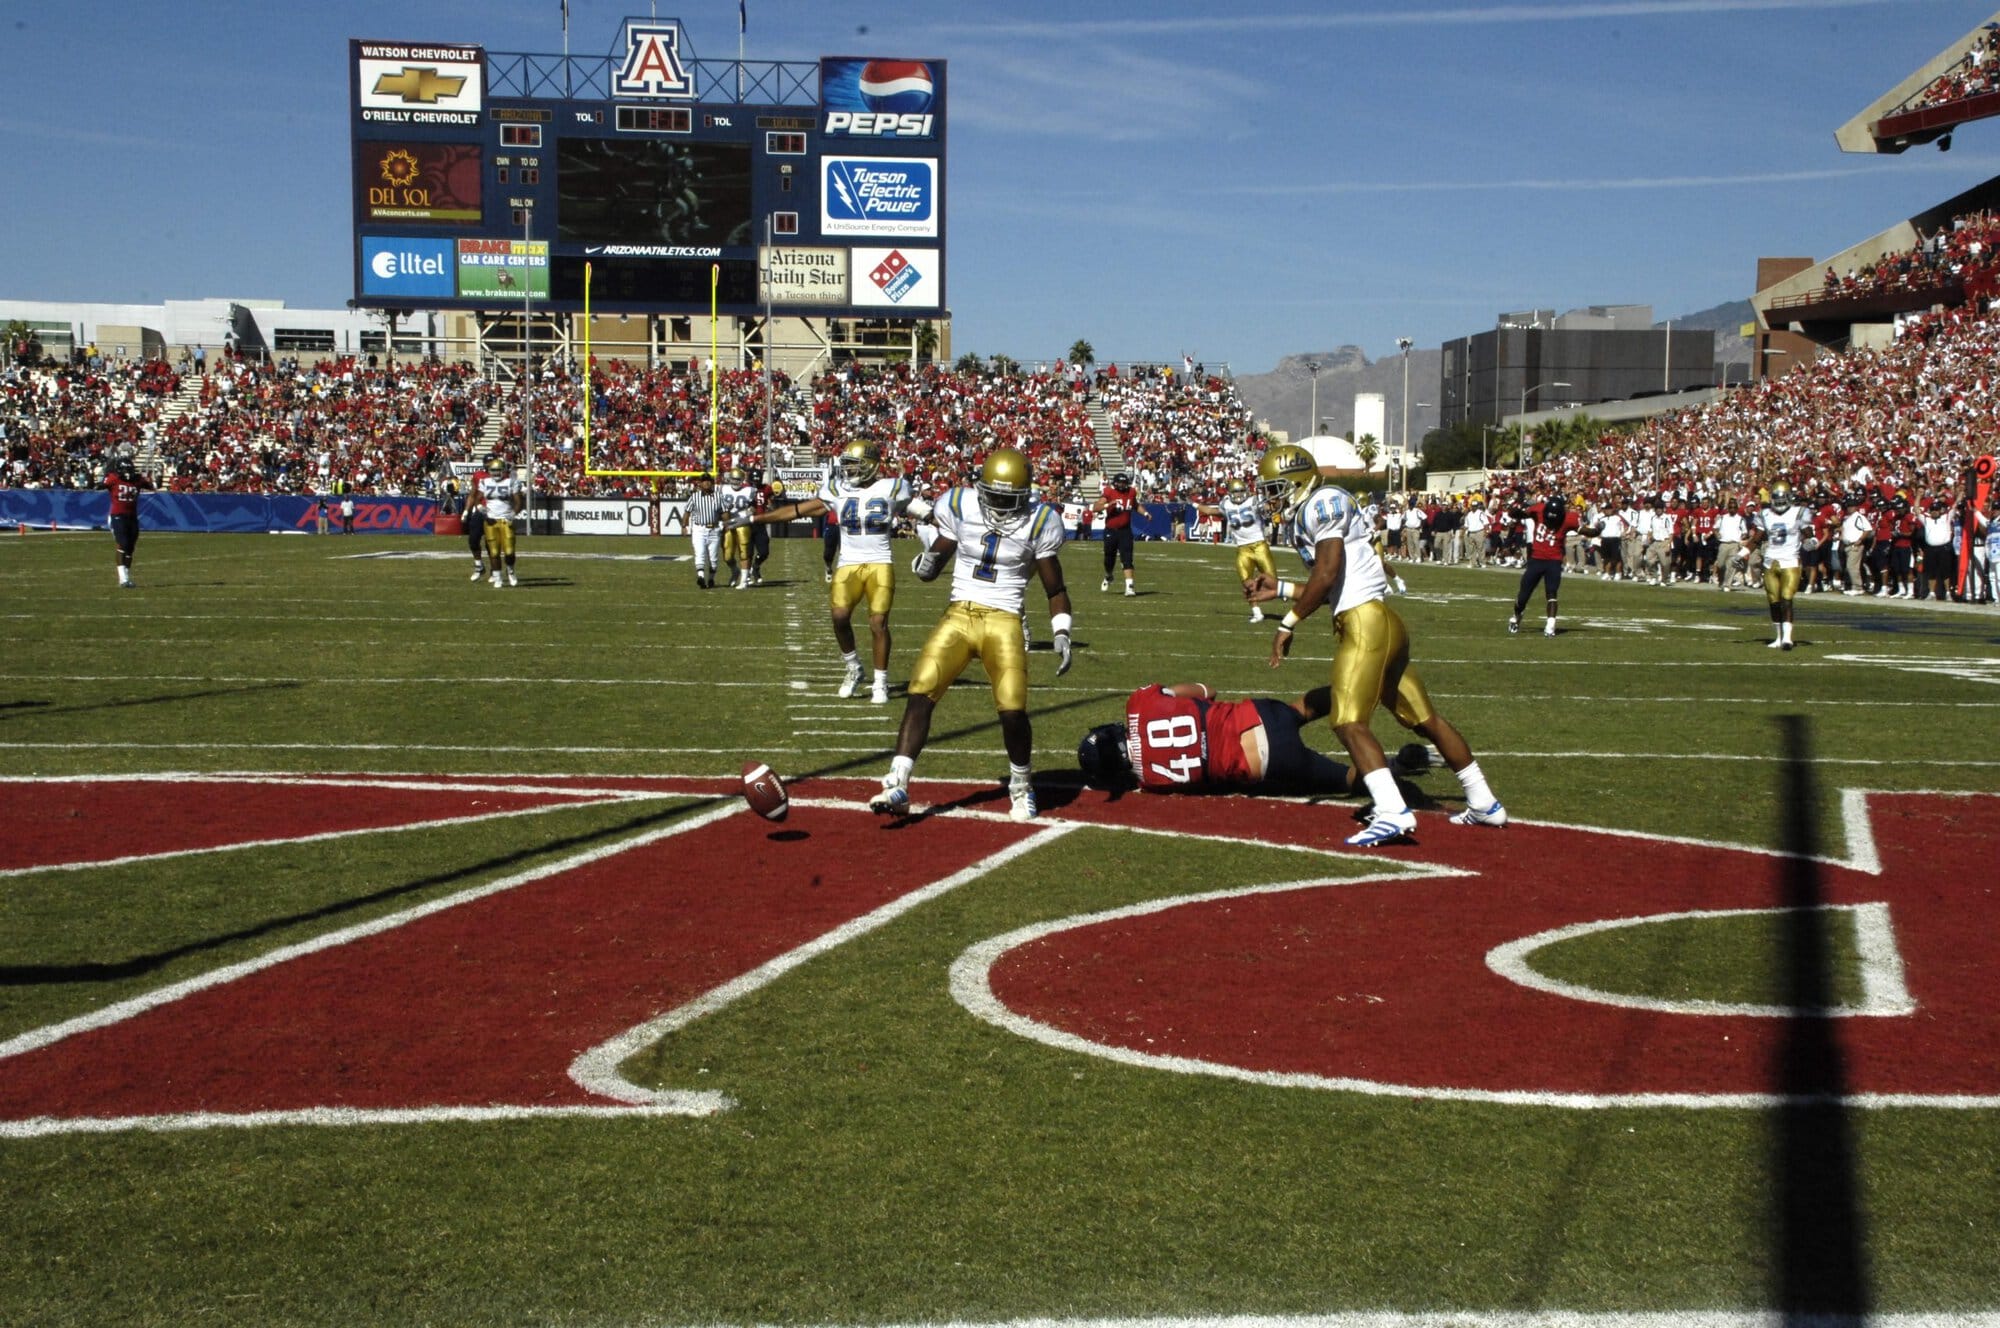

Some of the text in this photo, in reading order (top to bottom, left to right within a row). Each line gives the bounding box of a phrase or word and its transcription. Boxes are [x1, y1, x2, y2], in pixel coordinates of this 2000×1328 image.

[362, 46, 476, 60] WATSON CHEVROLET
[362, 110, 478, 124] O'RIELLY CHEVROLET
[576, 112, 594, 122] TOL
[713, 117, 732, 126] TOL
[825, 112, 933, 136] PEPSI
[853, 168, 907, 184] Tucson
[370, 187, 431, 207] DEL SOL
[858, 182, 921, 199] Electric
[864, 197, 921, 213] Power
[872, 224, 896, 232] Energy
[897, 224, 931, 232] Company
[603, 245, 721, 257] ARIZONAATHLETICS.COM
[770, 249, 835, 266] Arizona
[372, 252, 445, 278] alltel
[461, 255, 479, 265] CAR
[482, 255, 505, 265] CARE
[760, 268, 845, 288] Daily Star
[786, 290, 816, 299] Tucson
[819, 291, 843, 302] thing
[296, 502, 439, 528] ARZONA
[565, 510, 623, 521] MUSCLE MILK
[840, 496, 889, 536] 42
[1314, 495, 1344, 524] 11
[972, 529, 1001, 583] 1
[1147, 715, 1201, 784] 48
